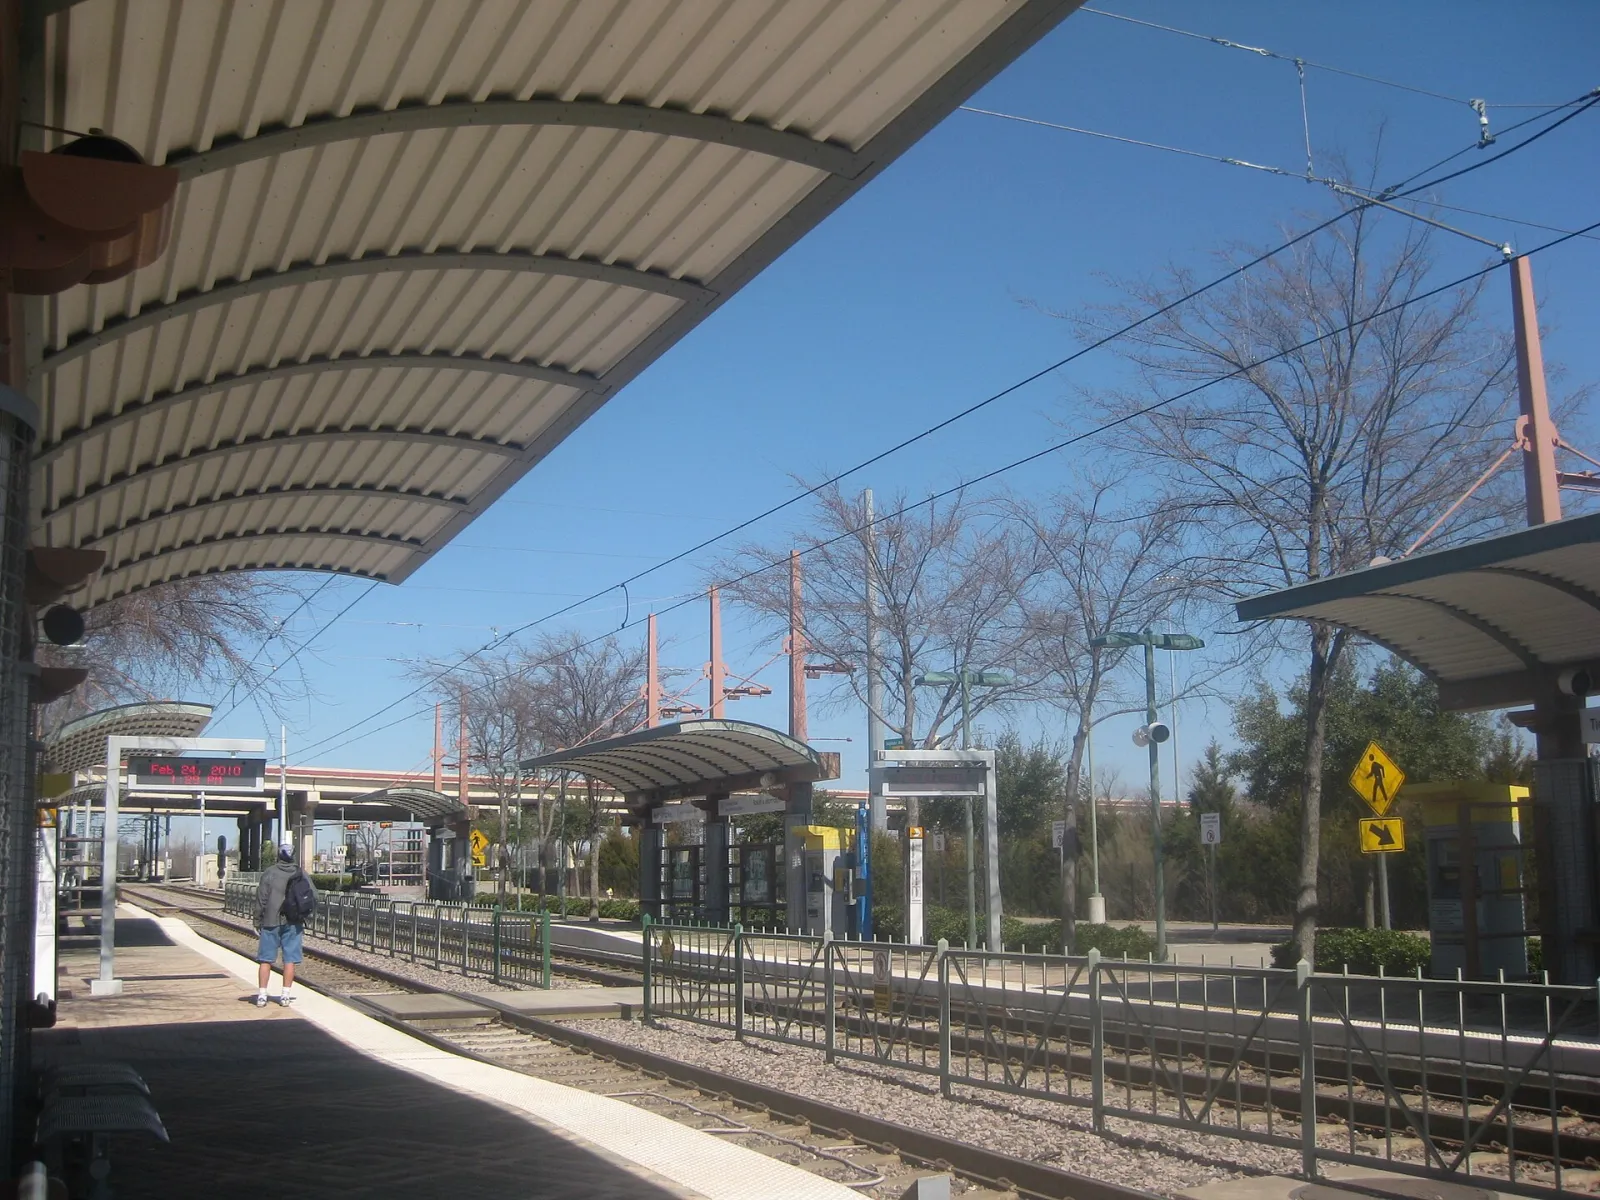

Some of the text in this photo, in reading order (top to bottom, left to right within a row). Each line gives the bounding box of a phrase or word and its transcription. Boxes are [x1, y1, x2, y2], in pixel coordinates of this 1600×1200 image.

[151, 763, 241, 776] Feb 24, 2010
[207, 775, 223, 785] PM
[337, 847, 345, 855] W
